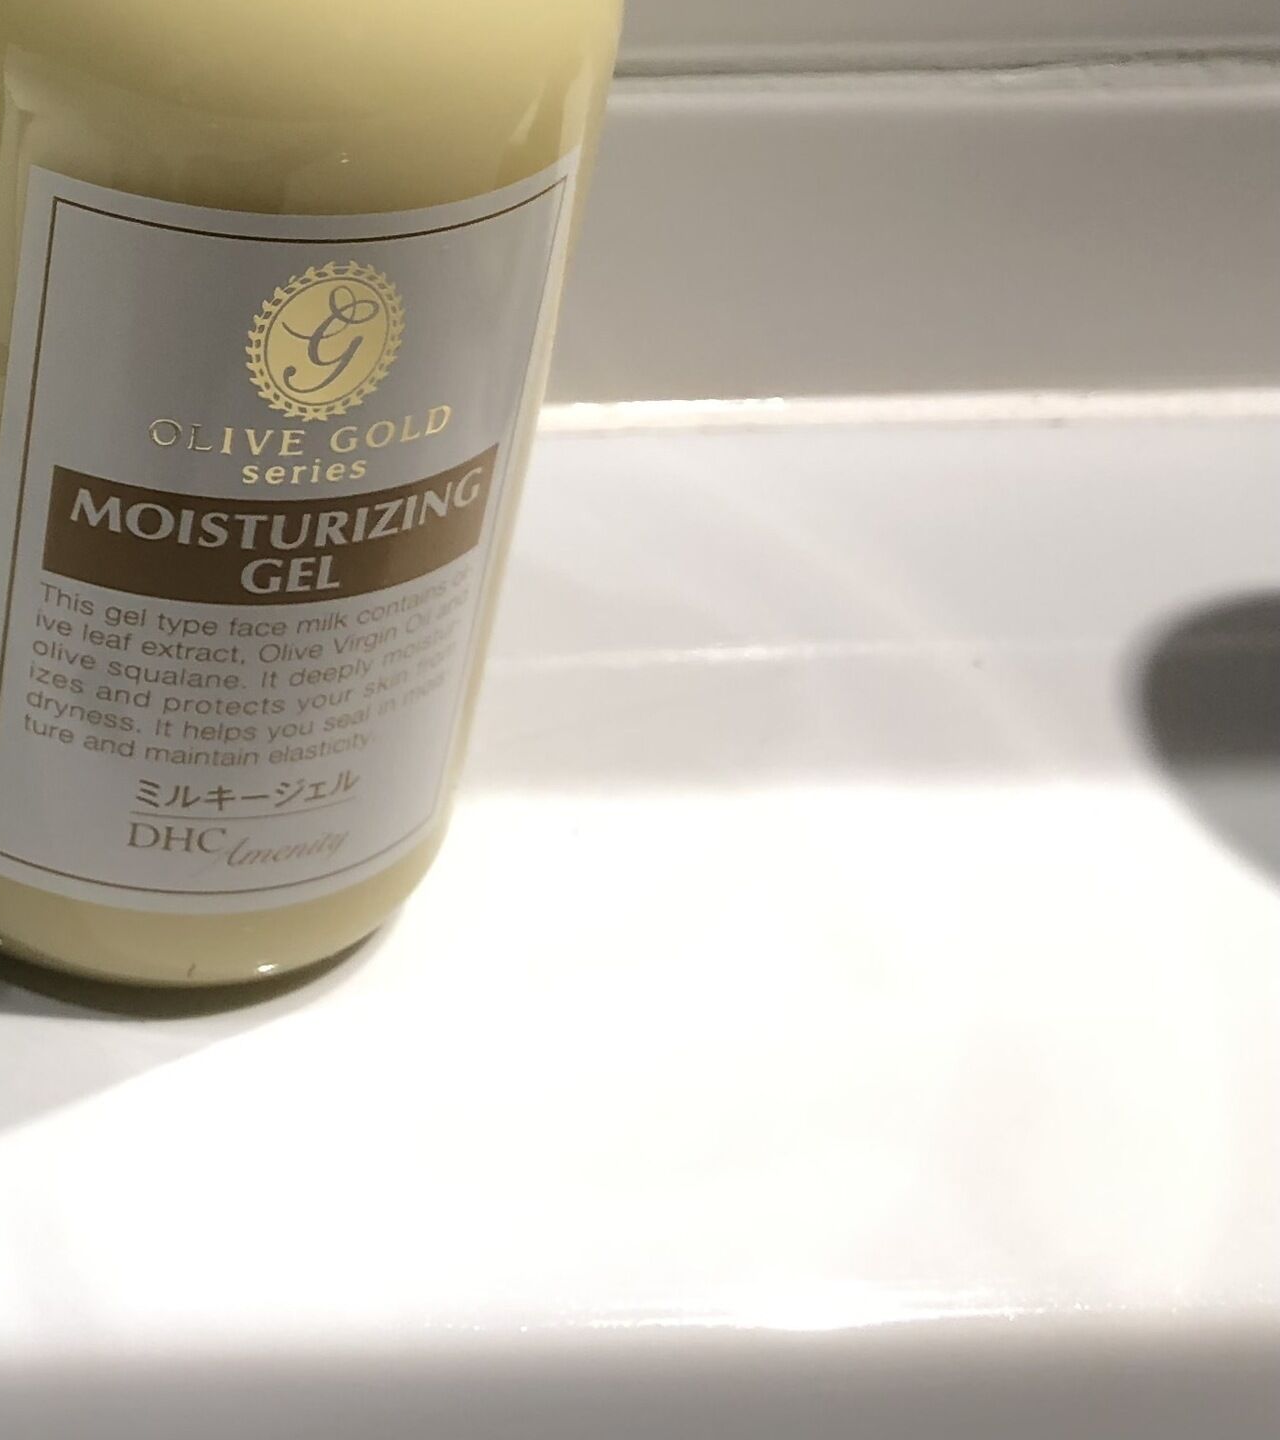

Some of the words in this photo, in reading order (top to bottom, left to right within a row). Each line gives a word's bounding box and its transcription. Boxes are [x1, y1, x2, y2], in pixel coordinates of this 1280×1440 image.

[149, 418, 306, 458] OLIVE
[330, 404, 452, 454] GOLD
[241, 458, 368, 485] series
[69, 467, 483, 551] MOISTURIZING
[240, 555, 340, 595] GEL
[41, 582, 95, 616] This
[104, 605, 147, 627] gel
[157, 613, 218, 637] type
[229, 617, 287, 637] face
[296, 612, 347, 634] milk
[356, 580, 447, 625] contains
[35, 609, 73, 636] ive
[82, 624, 133, 651] leaf
[259, 643, 323, 663] Olive
[333, 626, 398, 653] Virgin
[405, 610, 430, 634] Oil
[29, 661, 84, 694] izes
[96, 686, 151, 708] and
[162, 696, 285, 716] protects
[297, 689, 353, 712] your
[363, 668, 408, 699] skin
[32, 639, 96, 670] olive
[107, 661, 247, 690] squalane.
[261, 671, 277, 689] It
[289, 658, 372, 687] deeply
[24, 713, 75, 744] ture
[83, 735, 135, 757] and
[144, 746, 259, 767] maintain
[26, 690, 142, 734] dryness.
[155, 719, 172, 738] It
[183, 721, 256, 744] helps
[268, 720, 313, 744] you
[323, 706, 371, 733] seal
[136, 770, 359, 811] ミルキージェル
[128, 822, 229, 855] DHC
